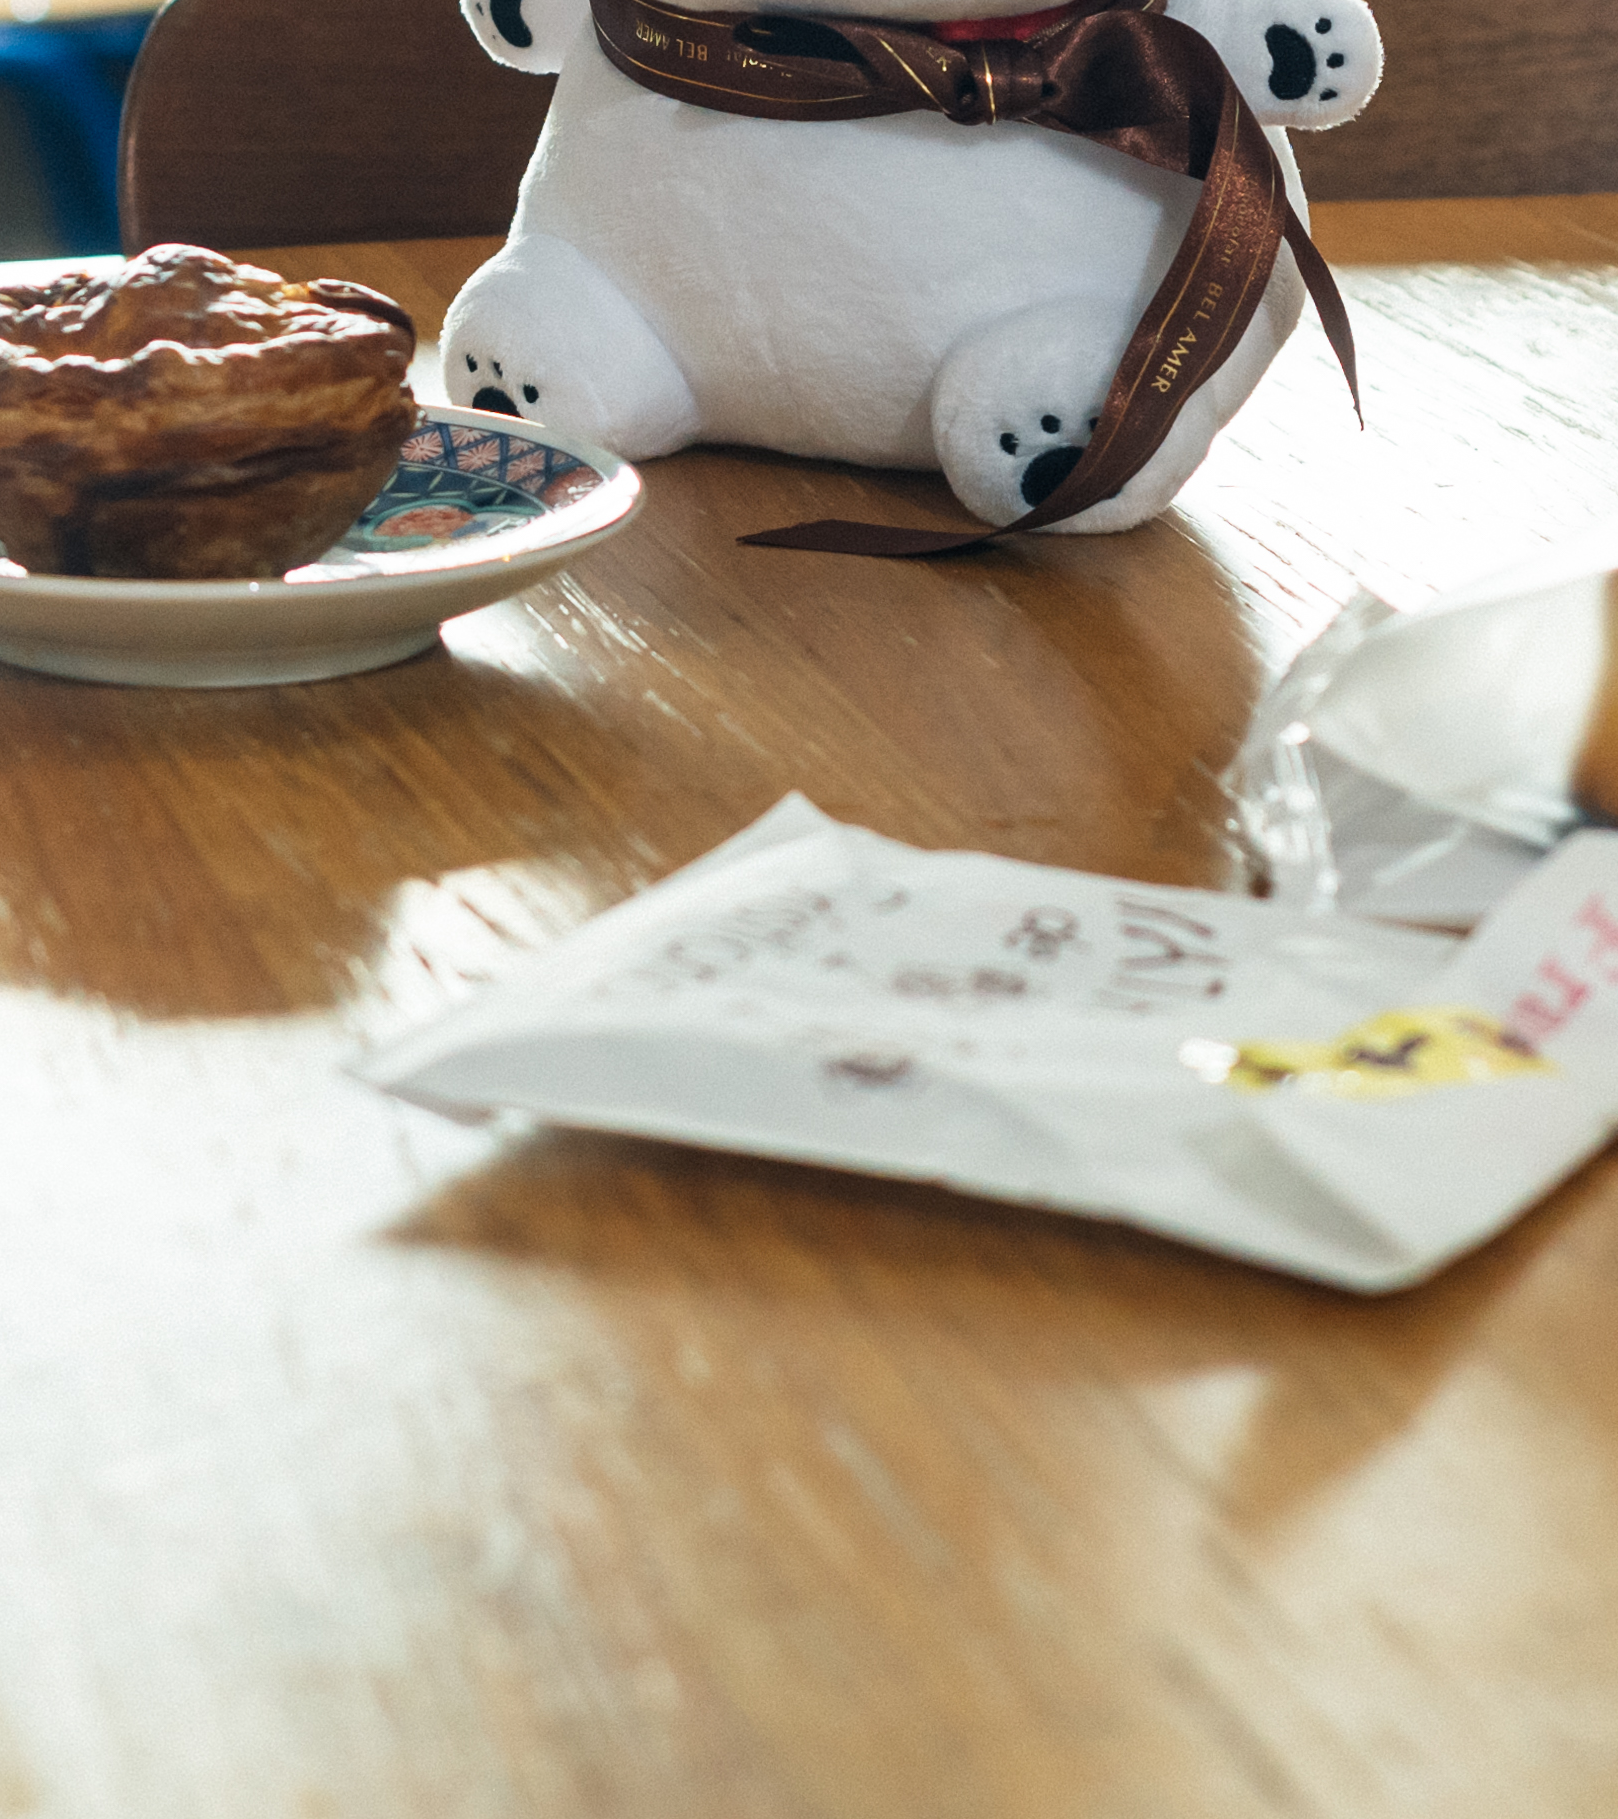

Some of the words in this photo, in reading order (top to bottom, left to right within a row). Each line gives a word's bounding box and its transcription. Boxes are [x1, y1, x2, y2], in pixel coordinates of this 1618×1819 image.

[635, 17, 672, 51] AMER
[675, 37, 709, 62] BEL
[1192, 281, 1224, 322] BEL
[1150, 326, 1198, 394] AMER
